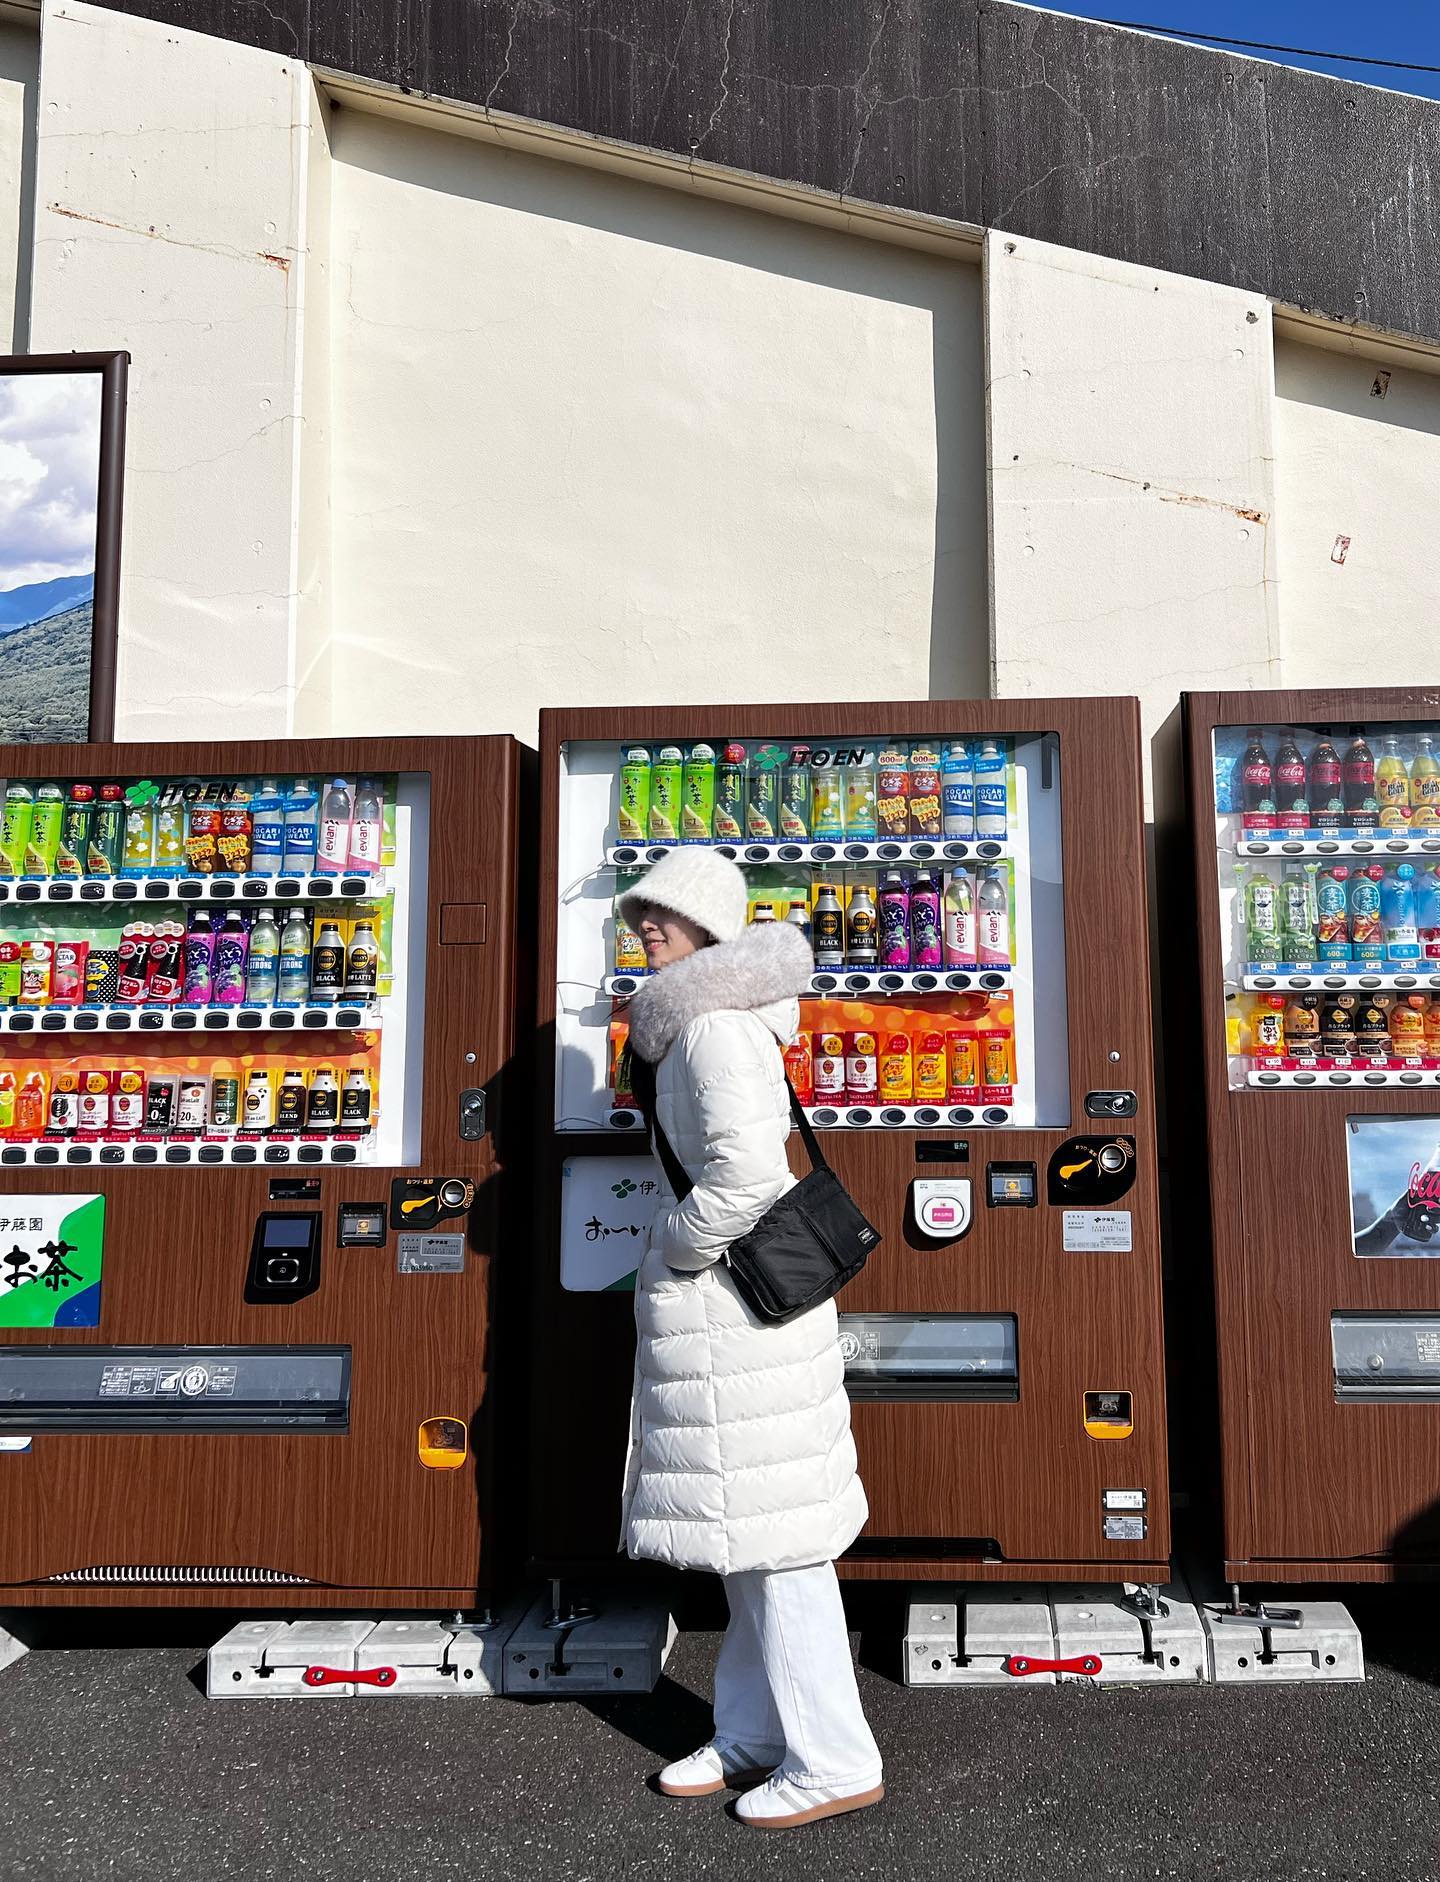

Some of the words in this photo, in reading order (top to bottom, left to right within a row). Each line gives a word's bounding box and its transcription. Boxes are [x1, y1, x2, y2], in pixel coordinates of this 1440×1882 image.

[790, 749, 831, 766] ITO
[833, 748, 866, 766] EN
[159, 782, 201, 801] ITO
[203, 782, 238, 801] EN
[325, 825, 335, 851] evian
[359, 825, 368, 852] evian
[956, 916, 965, 944] evian
[990, 915, 999, 943] evian
[249, 961, 273, 970] STRONG
[180, 1111, 191, 1121] 20
[0, 1240, 84, 1292] お茶
